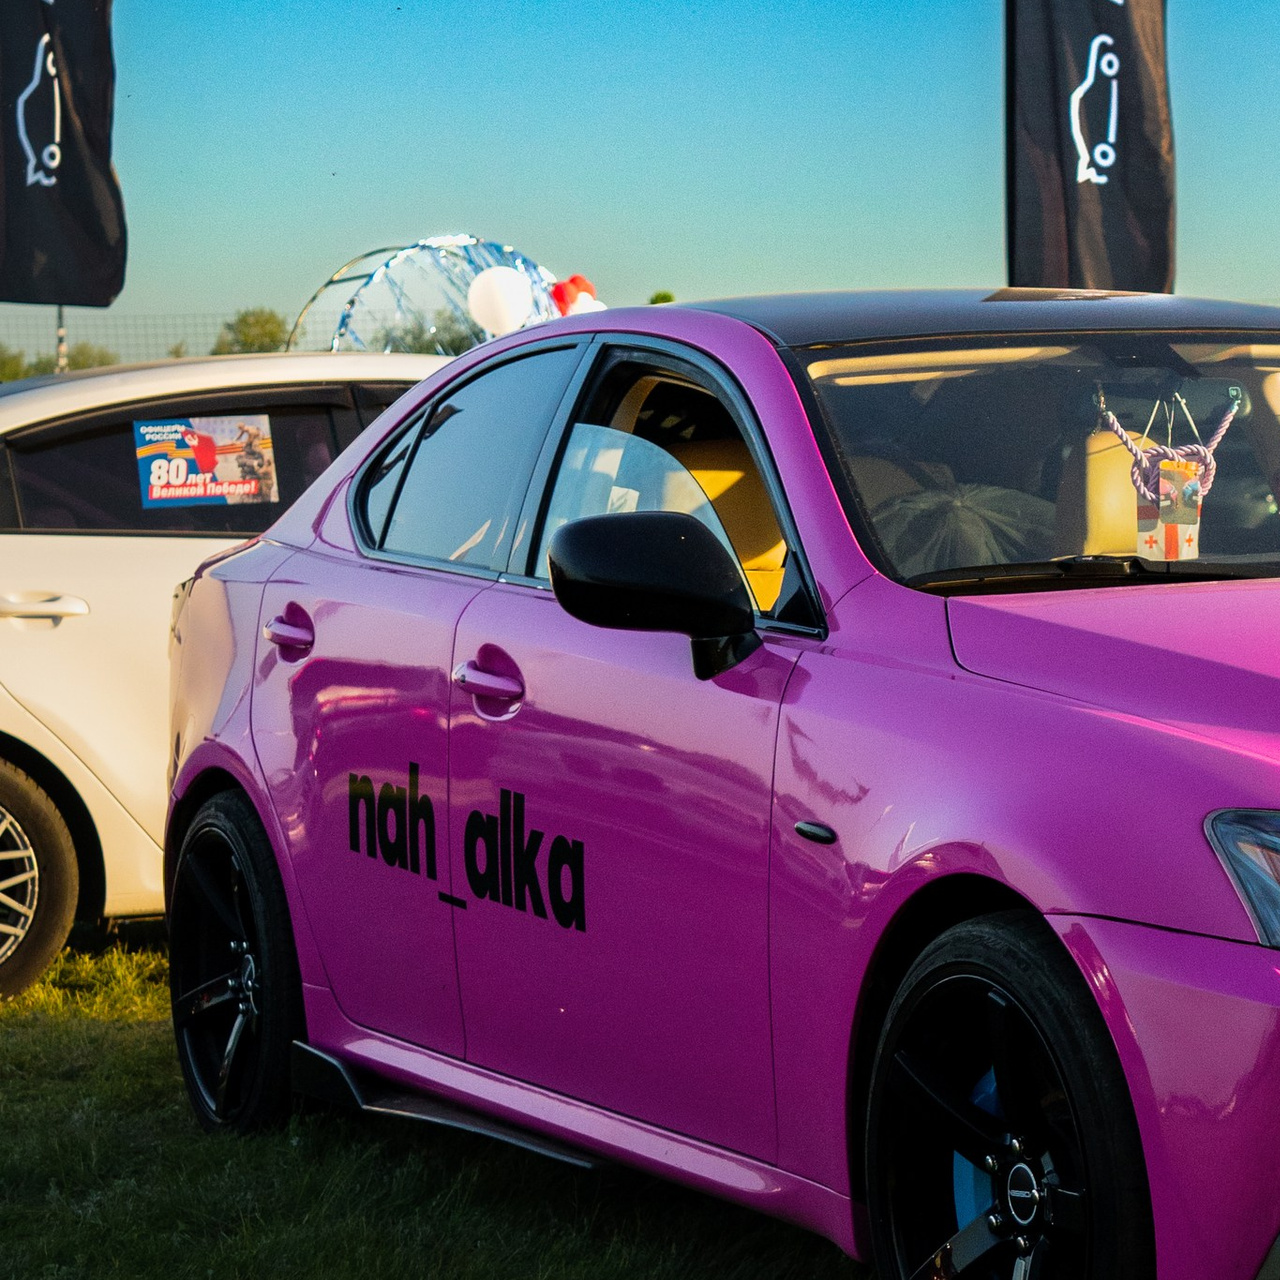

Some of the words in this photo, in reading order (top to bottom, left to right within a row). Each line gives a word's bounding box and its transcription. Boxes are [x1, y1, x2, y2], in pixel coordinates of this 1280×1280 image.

[150, 458, 187, 485] 80
[187, 472, 213, 484] лет
[152, 484, 205, 498] Великой
[349, 761, 586, 933] nah_alka
